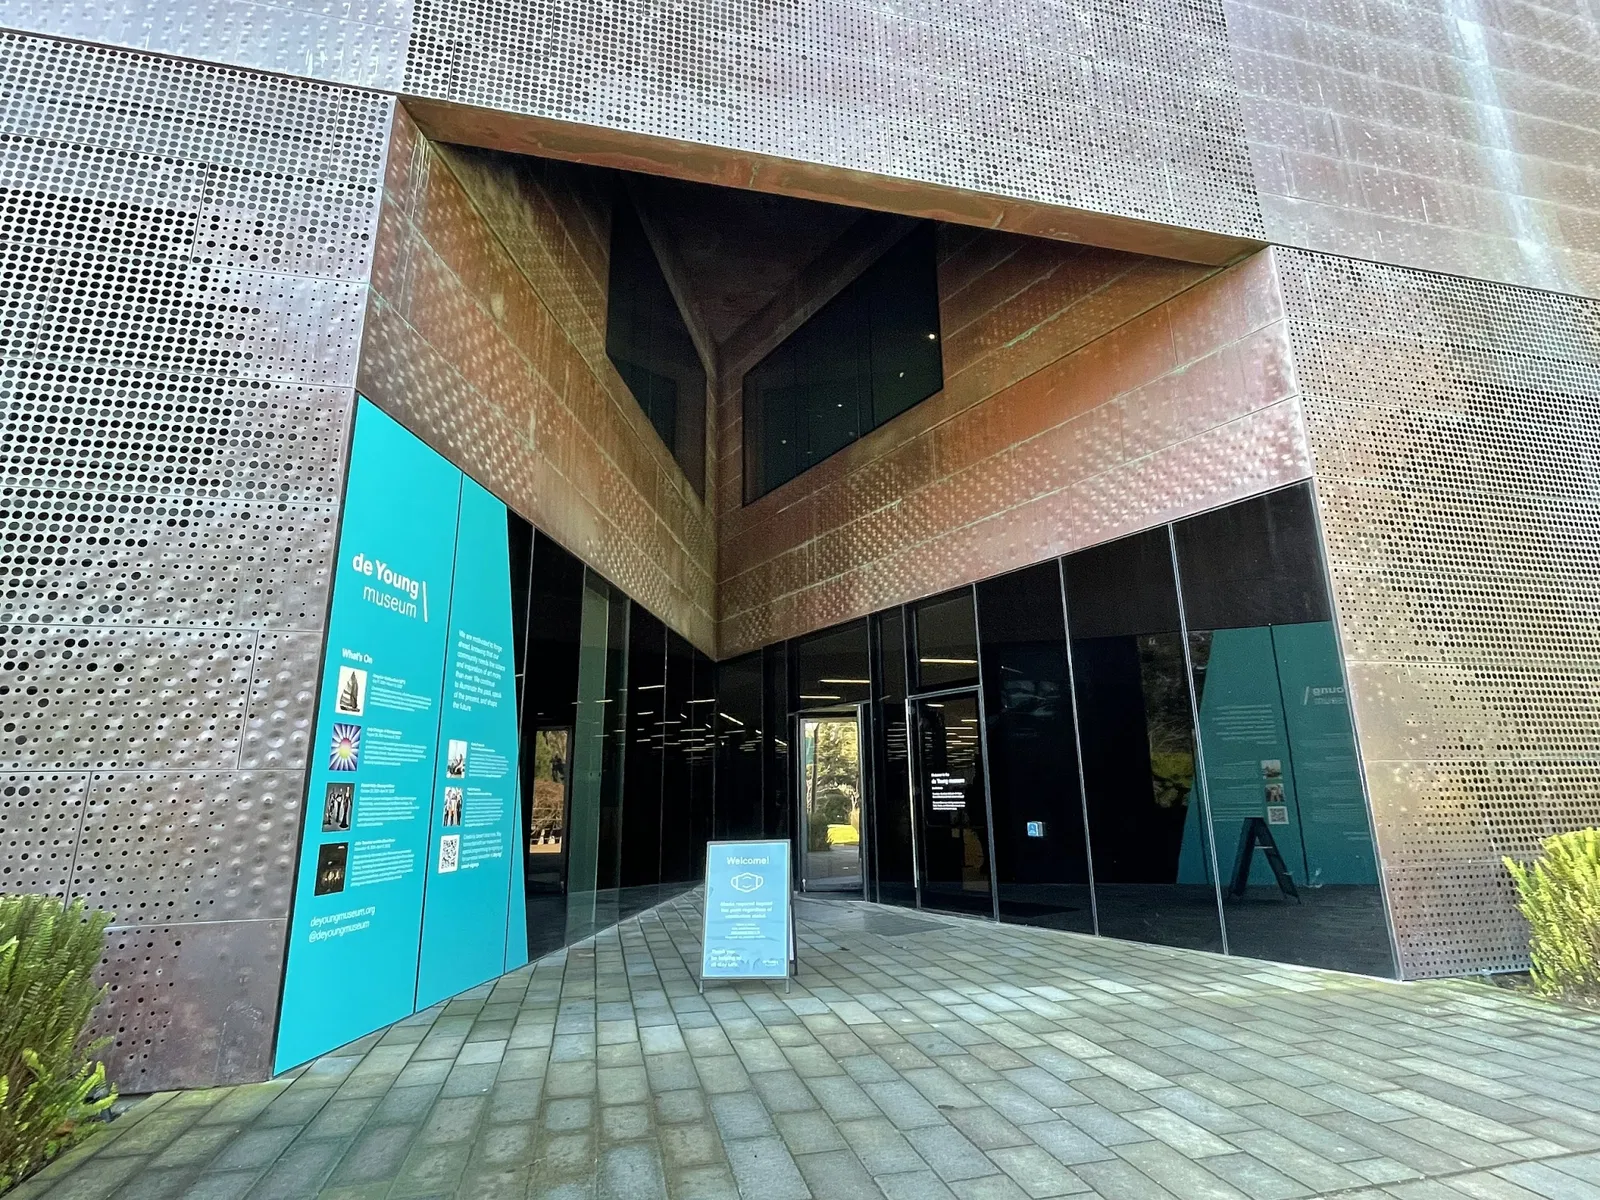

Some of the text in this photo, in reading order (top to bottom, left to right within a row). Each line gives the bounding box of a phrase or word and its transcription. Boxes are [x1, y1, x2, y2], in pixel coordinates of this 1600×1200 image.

[352, 552, 419, 600] de Young
[363, 586, 416, 618] museum
[342, 648, 373, 664] What's On
[726, 857, 770, 865] Welcome!
[310, 906, 375, 928] deyoungmuseum.org
[308, 921, 370, 943] @deyoungmuseum
